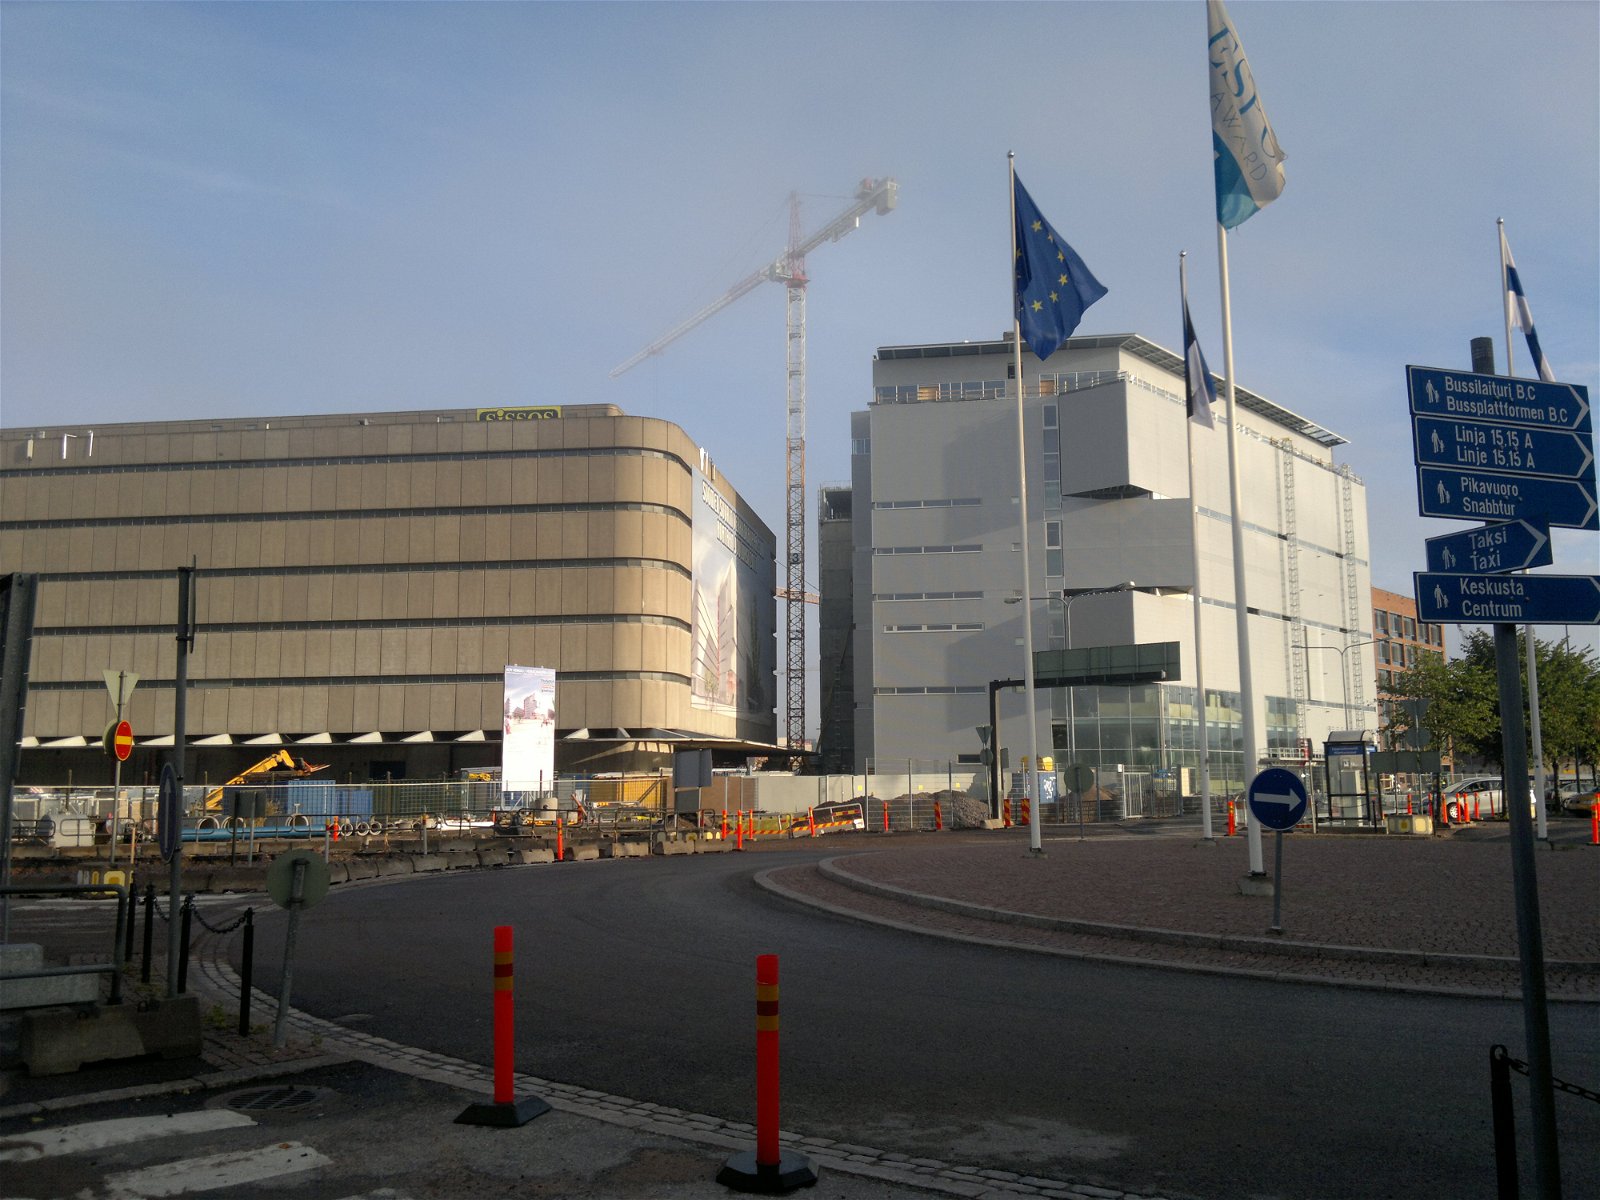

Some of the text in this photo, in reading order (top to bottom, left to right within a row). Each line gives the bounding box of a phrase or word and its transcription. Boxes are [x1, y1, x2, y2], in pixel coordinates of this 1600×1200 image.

[1211, 92, 1267, 181] AWARD
[1445, 375, 1512, 399] Bussilaituri
[1446, 395, 1545, 420] Bussplattformen
[1455, 425, 1486, 446] Linja
[1524, 432, 1534, 449] A
[1457, 445, 1488, 466] Linje
[1526, 452, 1536, 469] A
[1460, 476, 1519, 497] Pikavuoro
[1462, 496, 1516, 516] Snabbtur
[1468, 526, 1507, 550] Taksi
[792, 552, 799, 563] 3
[1469, 550, 1501, 571] Taxi
[1459, 577, 1524, 596] Keskusta
[1462, 600, 1522, 617] Centrum
